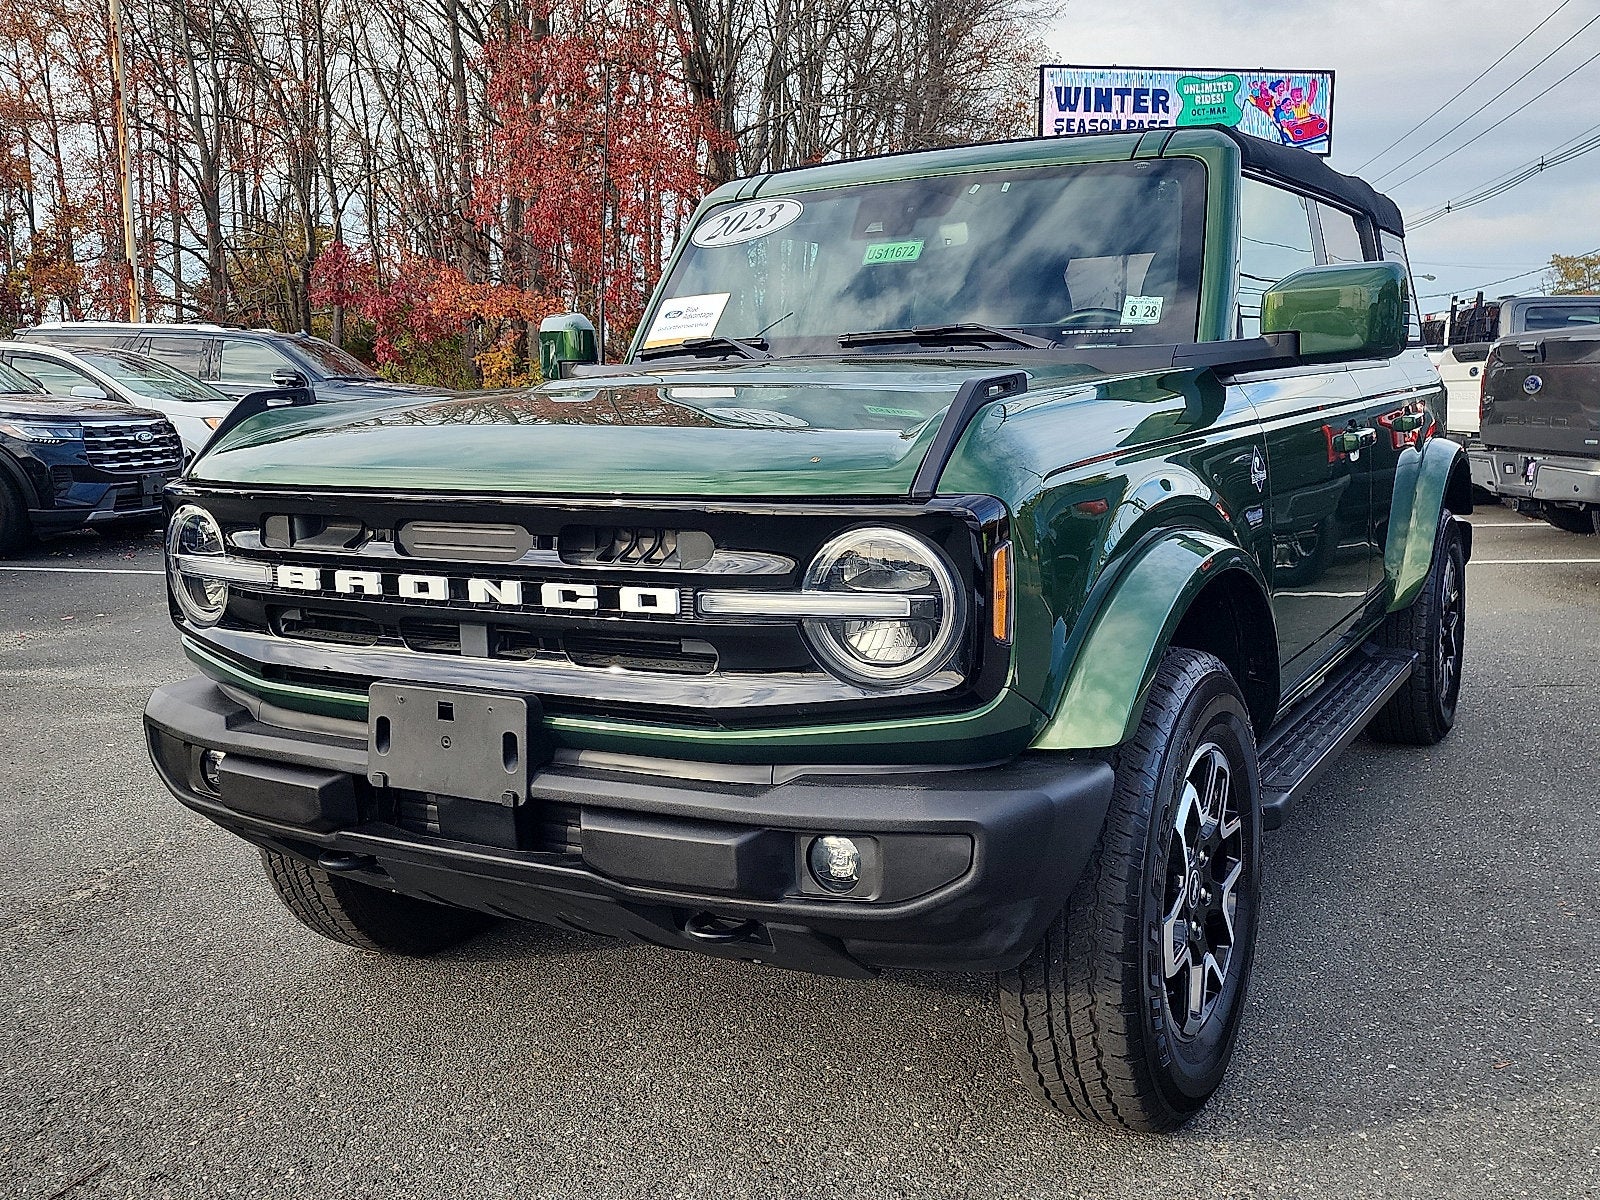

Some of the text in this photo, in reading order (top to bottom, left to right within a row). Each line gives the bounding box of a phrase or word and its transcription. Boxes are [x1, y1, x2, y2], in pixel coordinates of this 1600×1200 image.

[1183, 81, 1234, 95] UNLIMITED
[1054, 86, 1170, 114] WINTER
[1194, 93, 1225, 106] RIDES!
[1191, 106, 1227, 117] OCT-MAR
[1054, 118, 1122, 133] SEASON
[707, 203, 785, 241] 2023
[867, 245, 916, 261] US11672
[1129, 304, 1158, 318] 8 28
[276, 564, 681, 615] BRONCO
